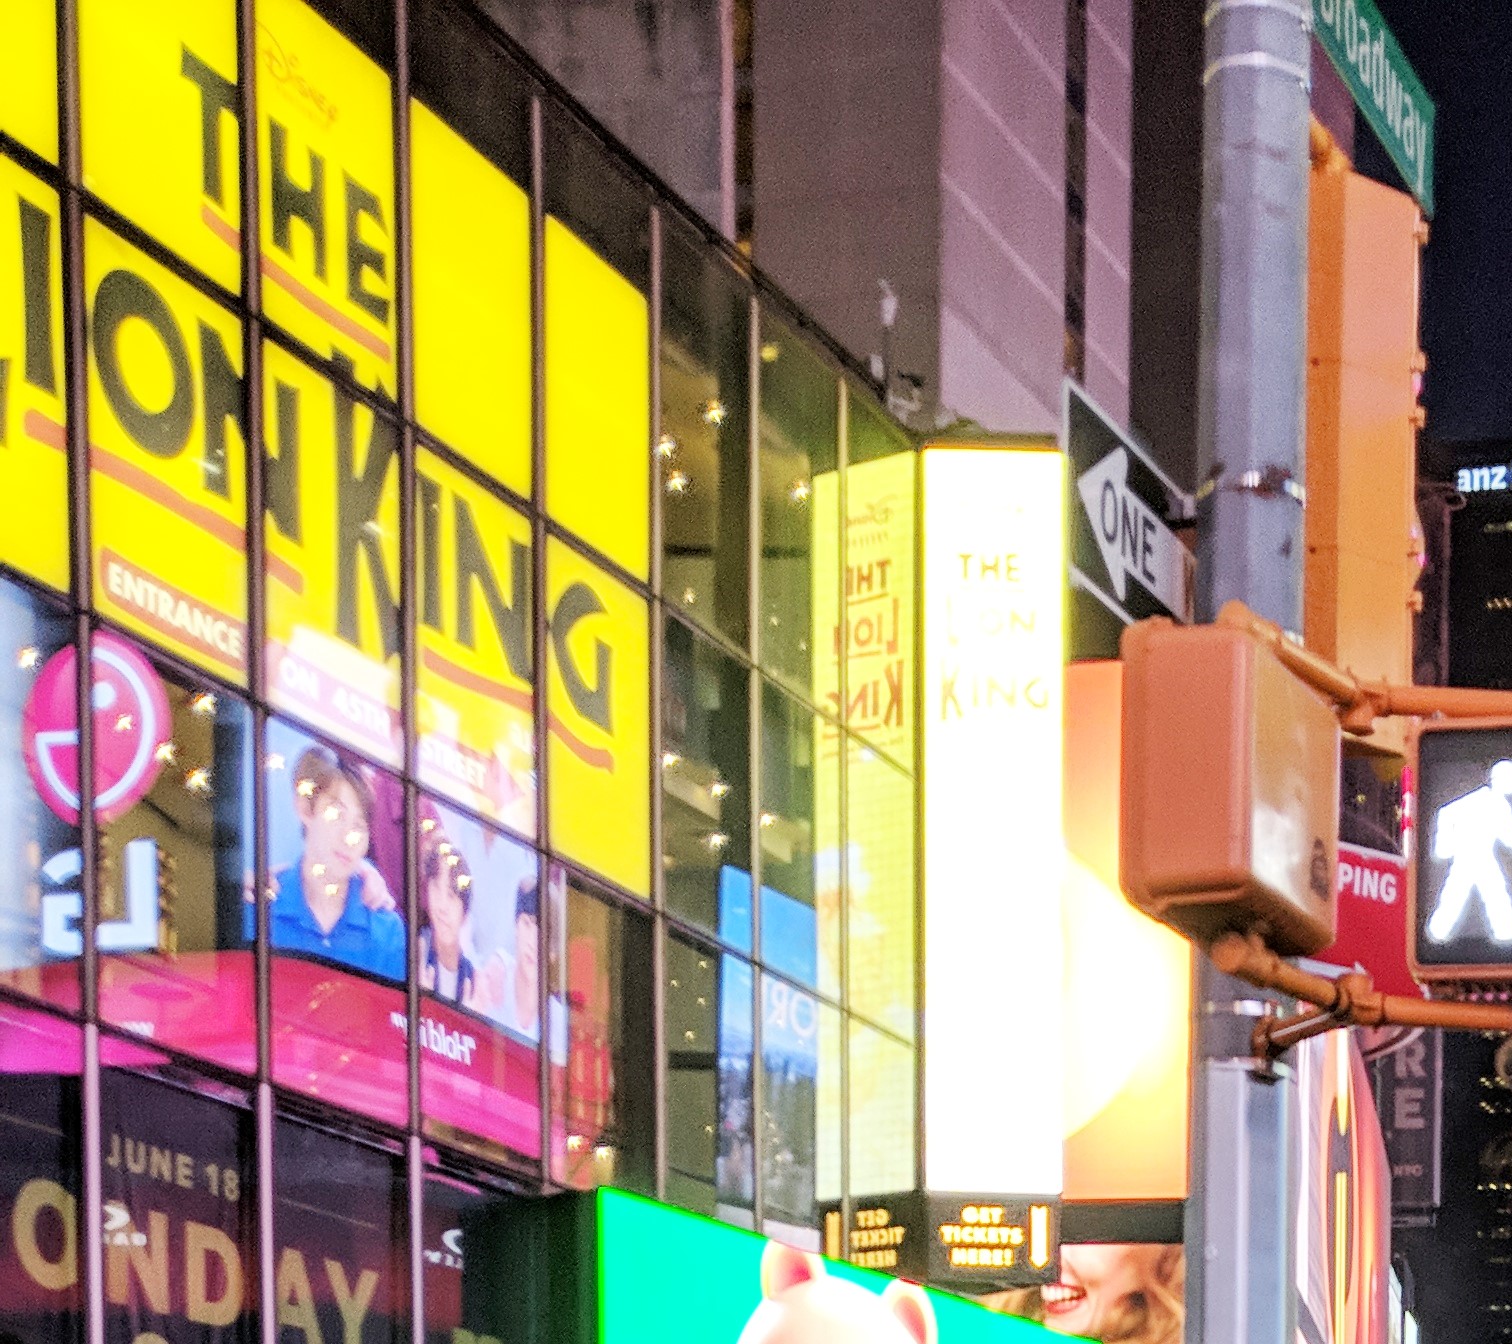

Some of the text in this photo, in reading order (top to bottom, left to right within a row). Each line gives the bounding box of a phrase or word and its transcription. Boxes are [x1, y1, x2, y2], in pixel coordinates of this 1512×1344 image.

[181, 40, 393, 326] THE
[0, 192, 614, 737] ION KING
[1101, 478, 1156, 585] ONE
[957, 552, 1022, 582] THE
[107, 561, 242, 656] ENTRANCE
[938, 658, 1050, 722] KING
[1338, 862, 1397, 904] PING
[105, 1133, 241, 1203] JUNE 18
[940, 1224, 1025, 1246] TICKETS
[960, 1205, 1004, 1225] GET
[949, 1247, 1014, 1267] HERE!
